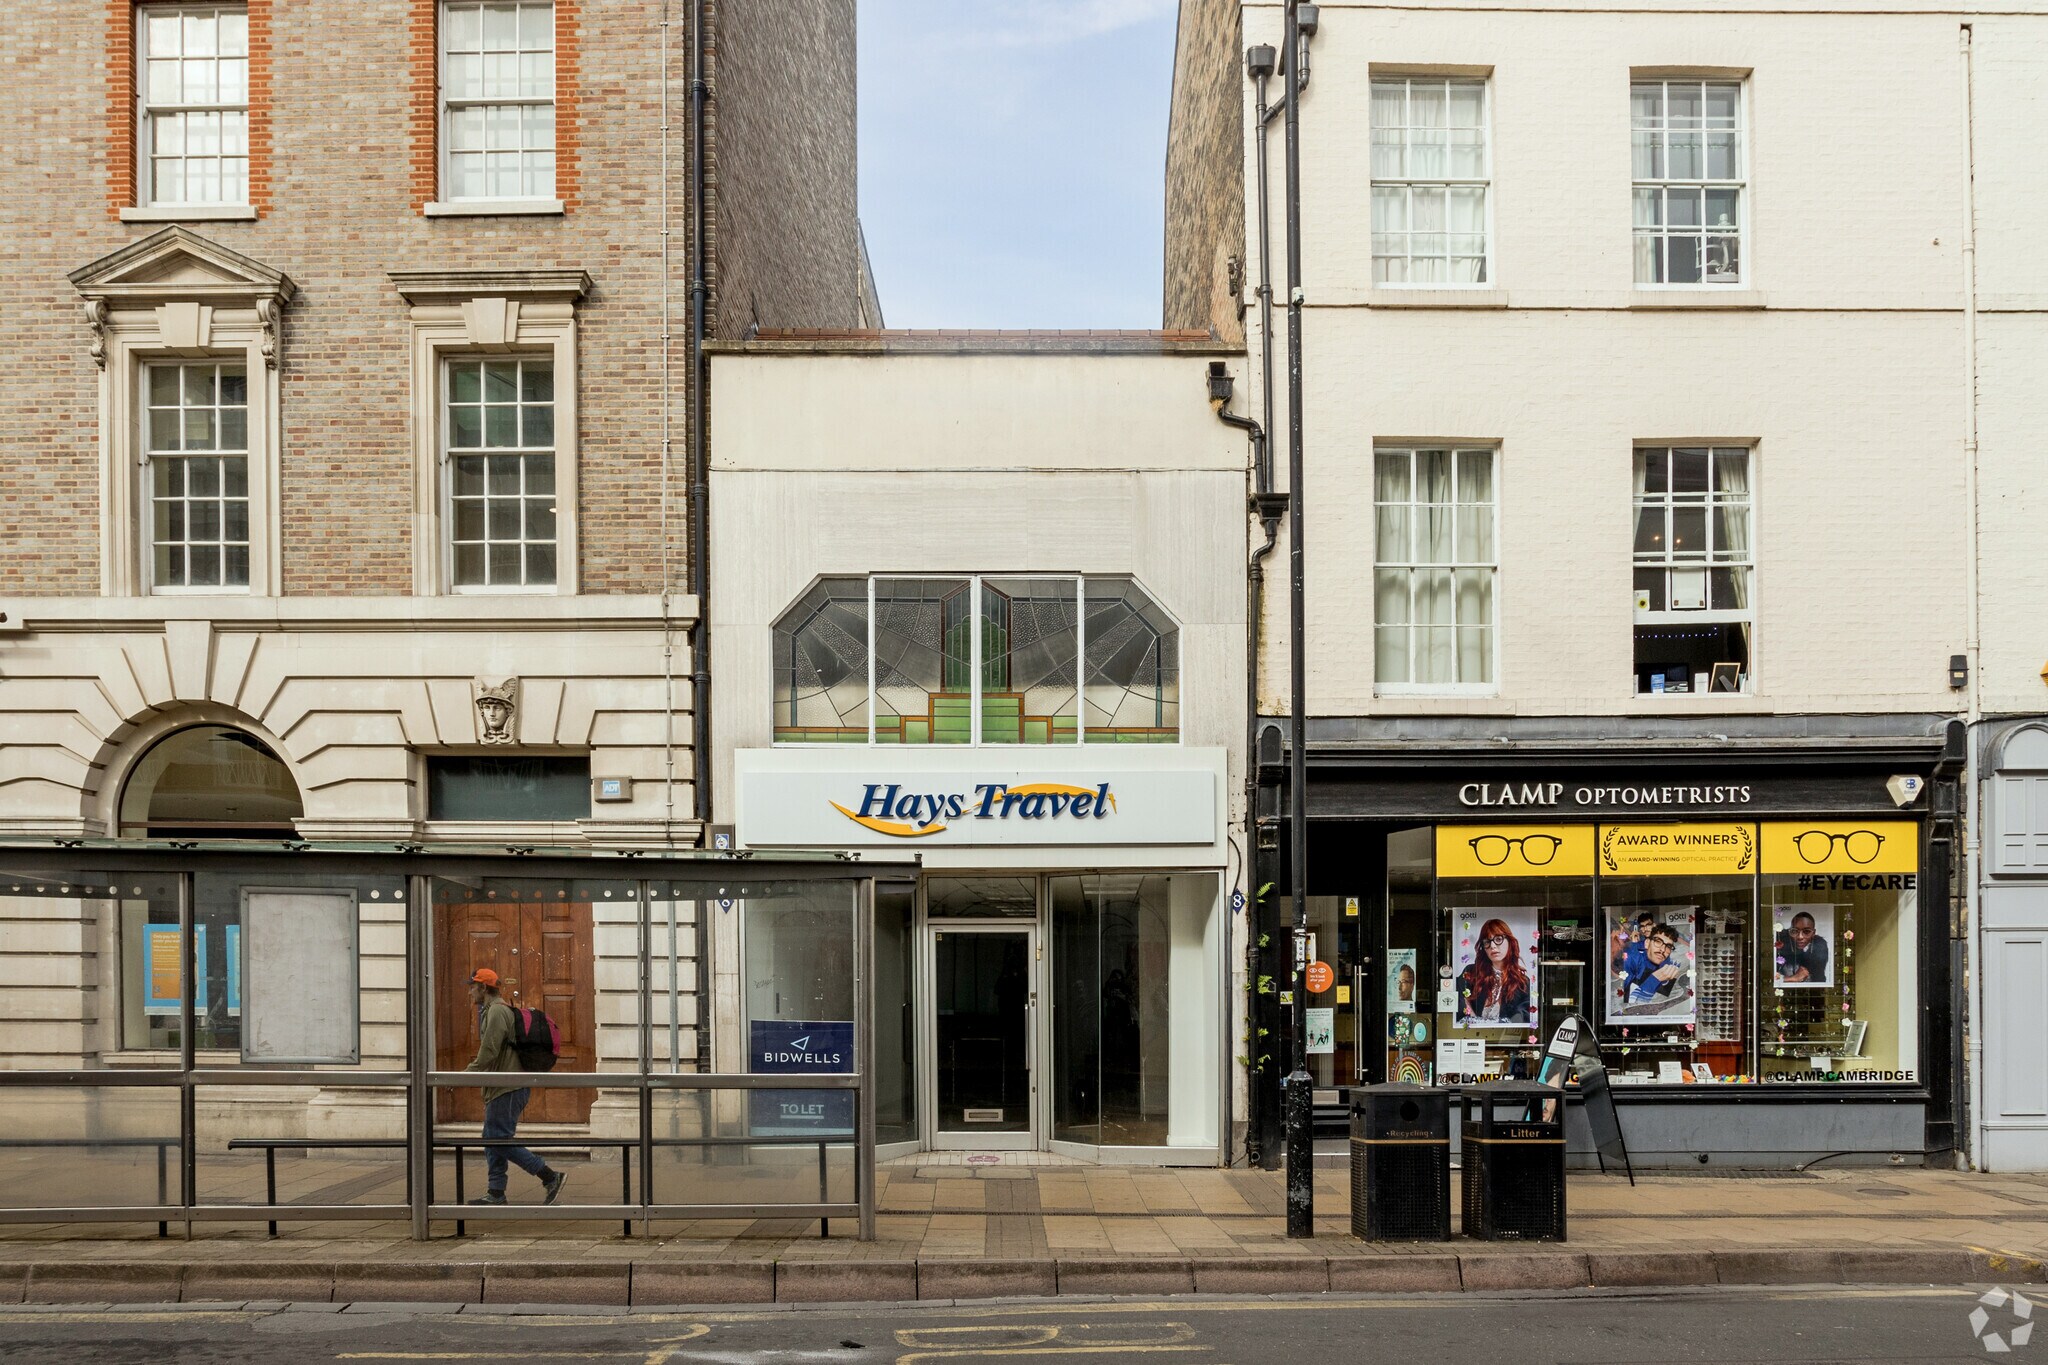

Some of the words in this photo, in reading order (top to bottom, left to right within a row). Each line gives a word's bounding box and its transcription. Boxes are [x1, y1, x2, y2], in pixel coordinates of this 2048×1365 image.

[1458, 783, 1564, 806] CLAMP
[1574, 786, 1751, 805] OPTOMETRISTS
[855, 784, 964, 827] Hays
[973, 782, 1110, 819] Travel
[1617, 835, 1669, 845] AWARD
[1674, 834, 1739, 845] WINNERS
[1798, 874, 1917, 891] #EYECARE
[1233, 894, 1242, 908] 8
[1558, 1030, 1576, 1042] CLAMP
[764, 1052, 841, 1064] BIDWELLS
[1764, 1070, 1914, 1083] @CLAMPCAMBRIDGE
[780, 1104, 799, 1115] TO
[801, 1104, 825, 1115] LET
[1390, 1129, 1429, 1139] Recycling
[1510, 1128, 1540, 1138] Litter
